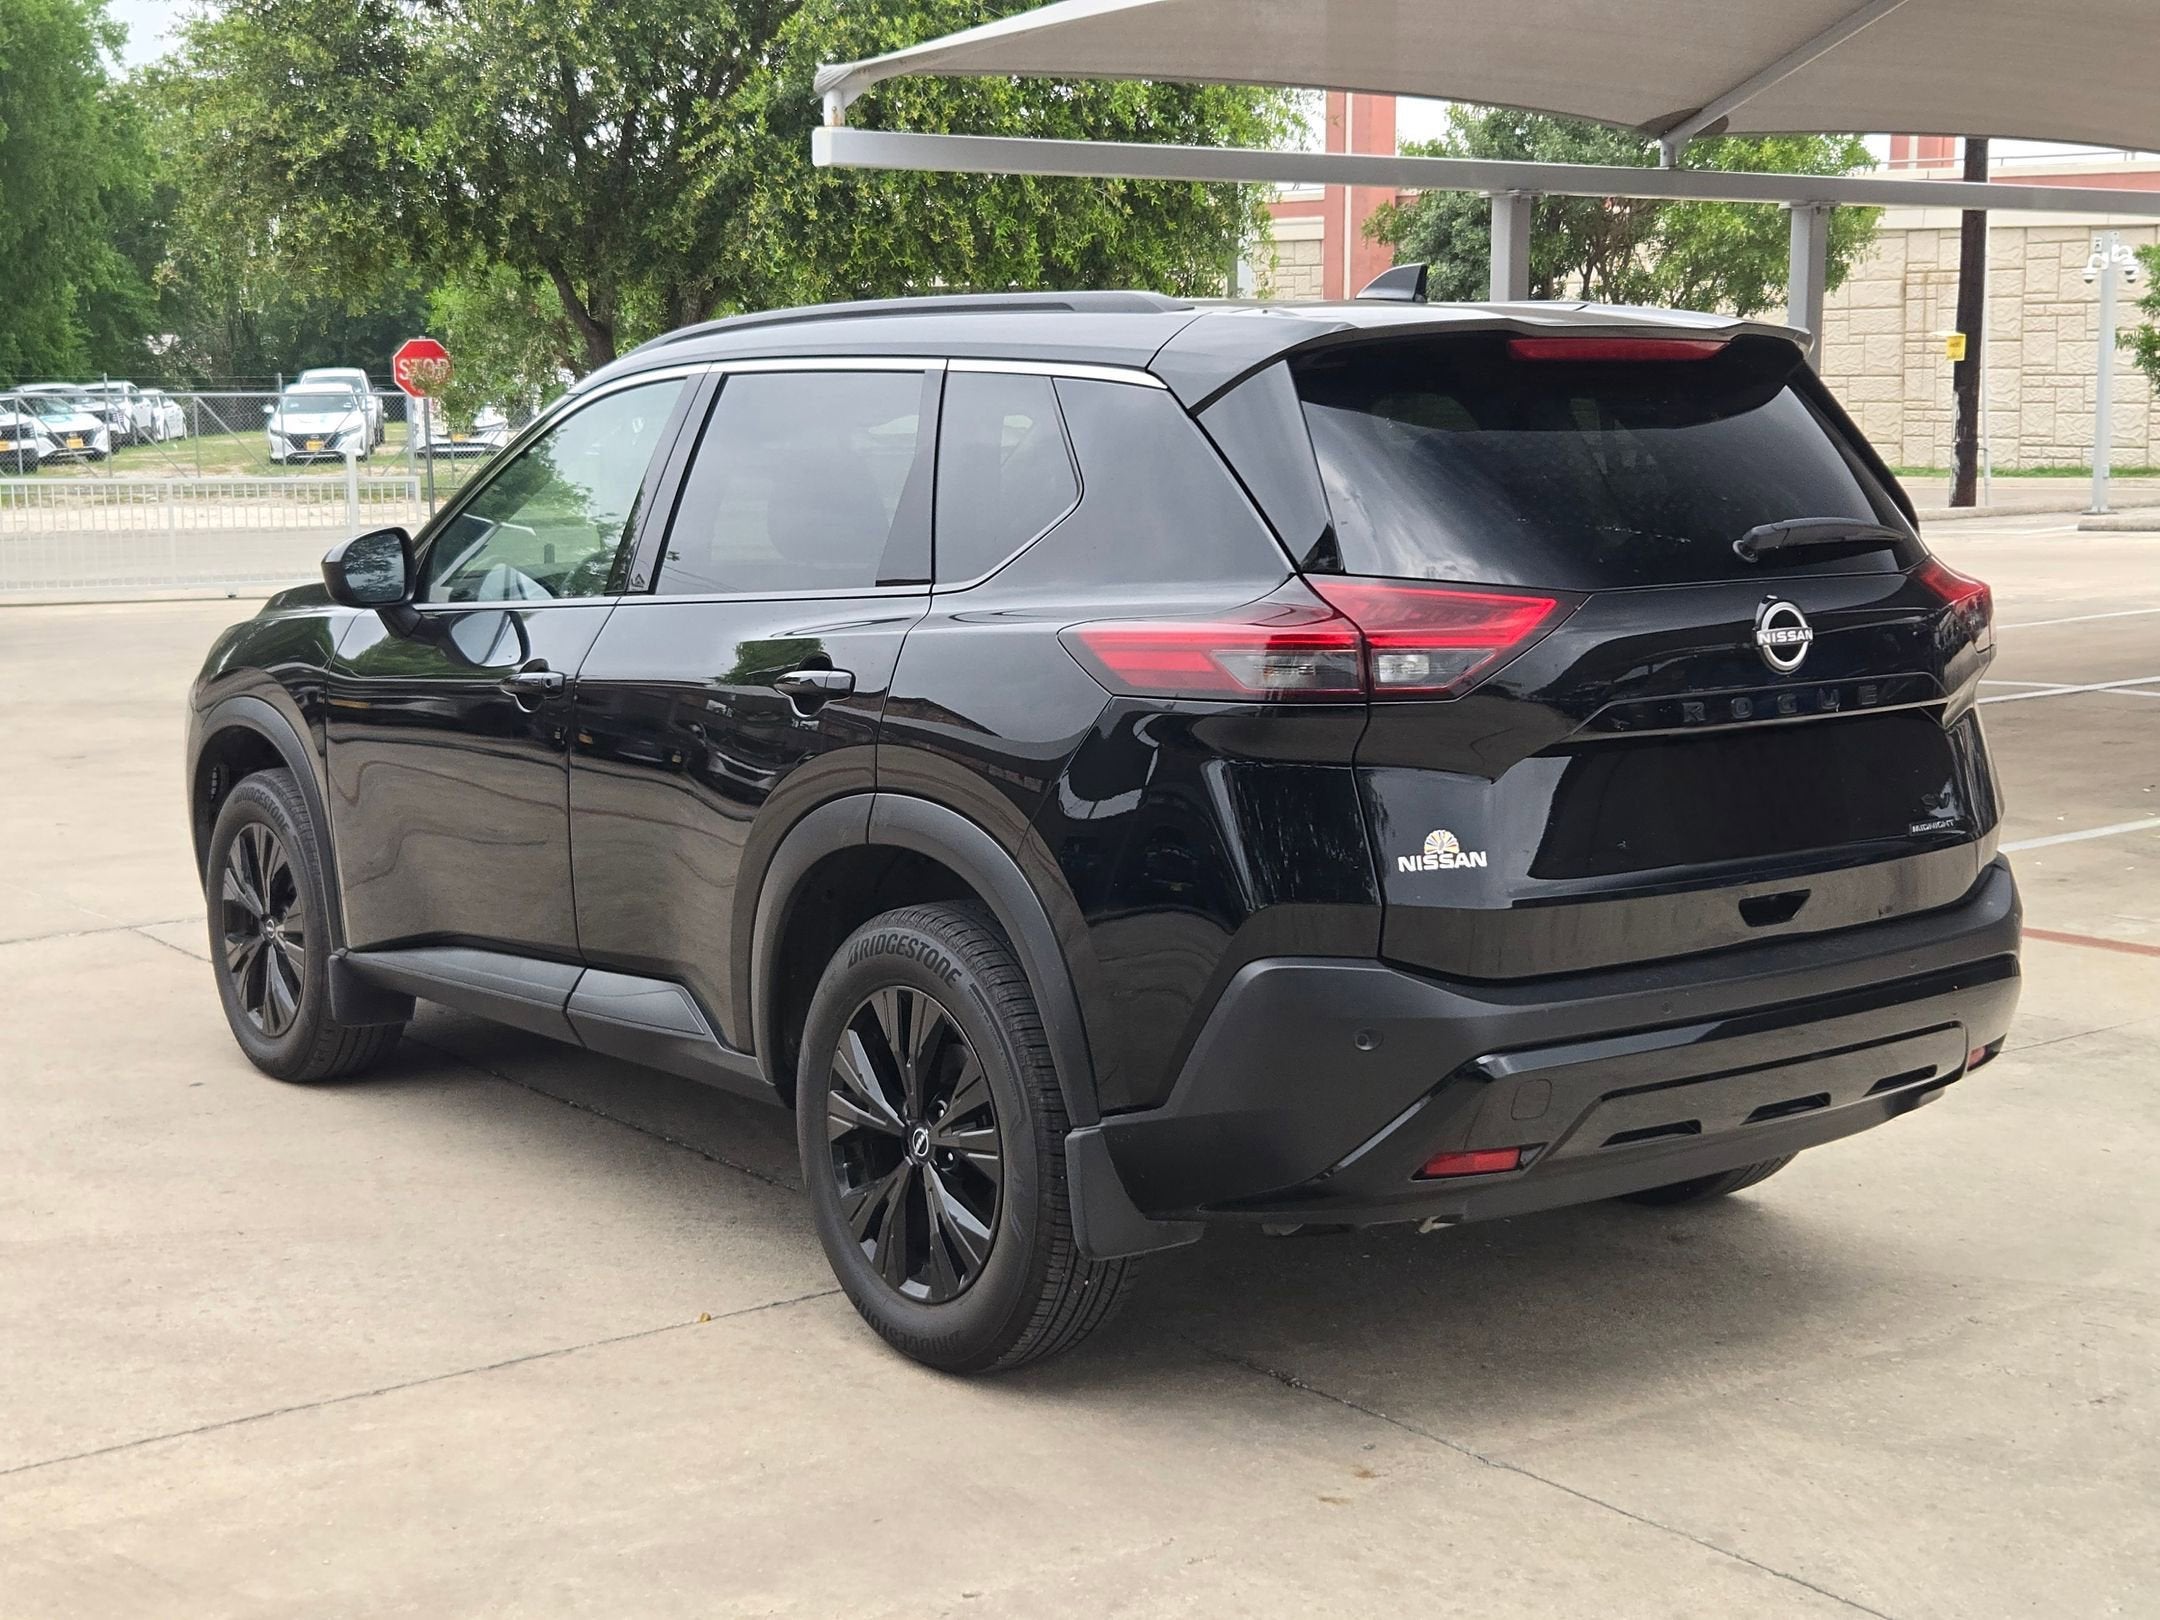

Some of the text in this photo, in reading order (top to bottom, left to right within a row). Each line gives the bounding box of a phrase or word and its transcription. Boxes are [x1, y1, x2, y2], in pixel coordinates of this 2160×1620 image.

[1758, 629, 1813, 645] NISSAN
[1682, 685, 1878, 722] ROGUE
[1920, 793, 1951, 812] SV
[1397, 851, 1488, 872] NISSAN
[848, 934, 962, 988] BRIDGESTONE
